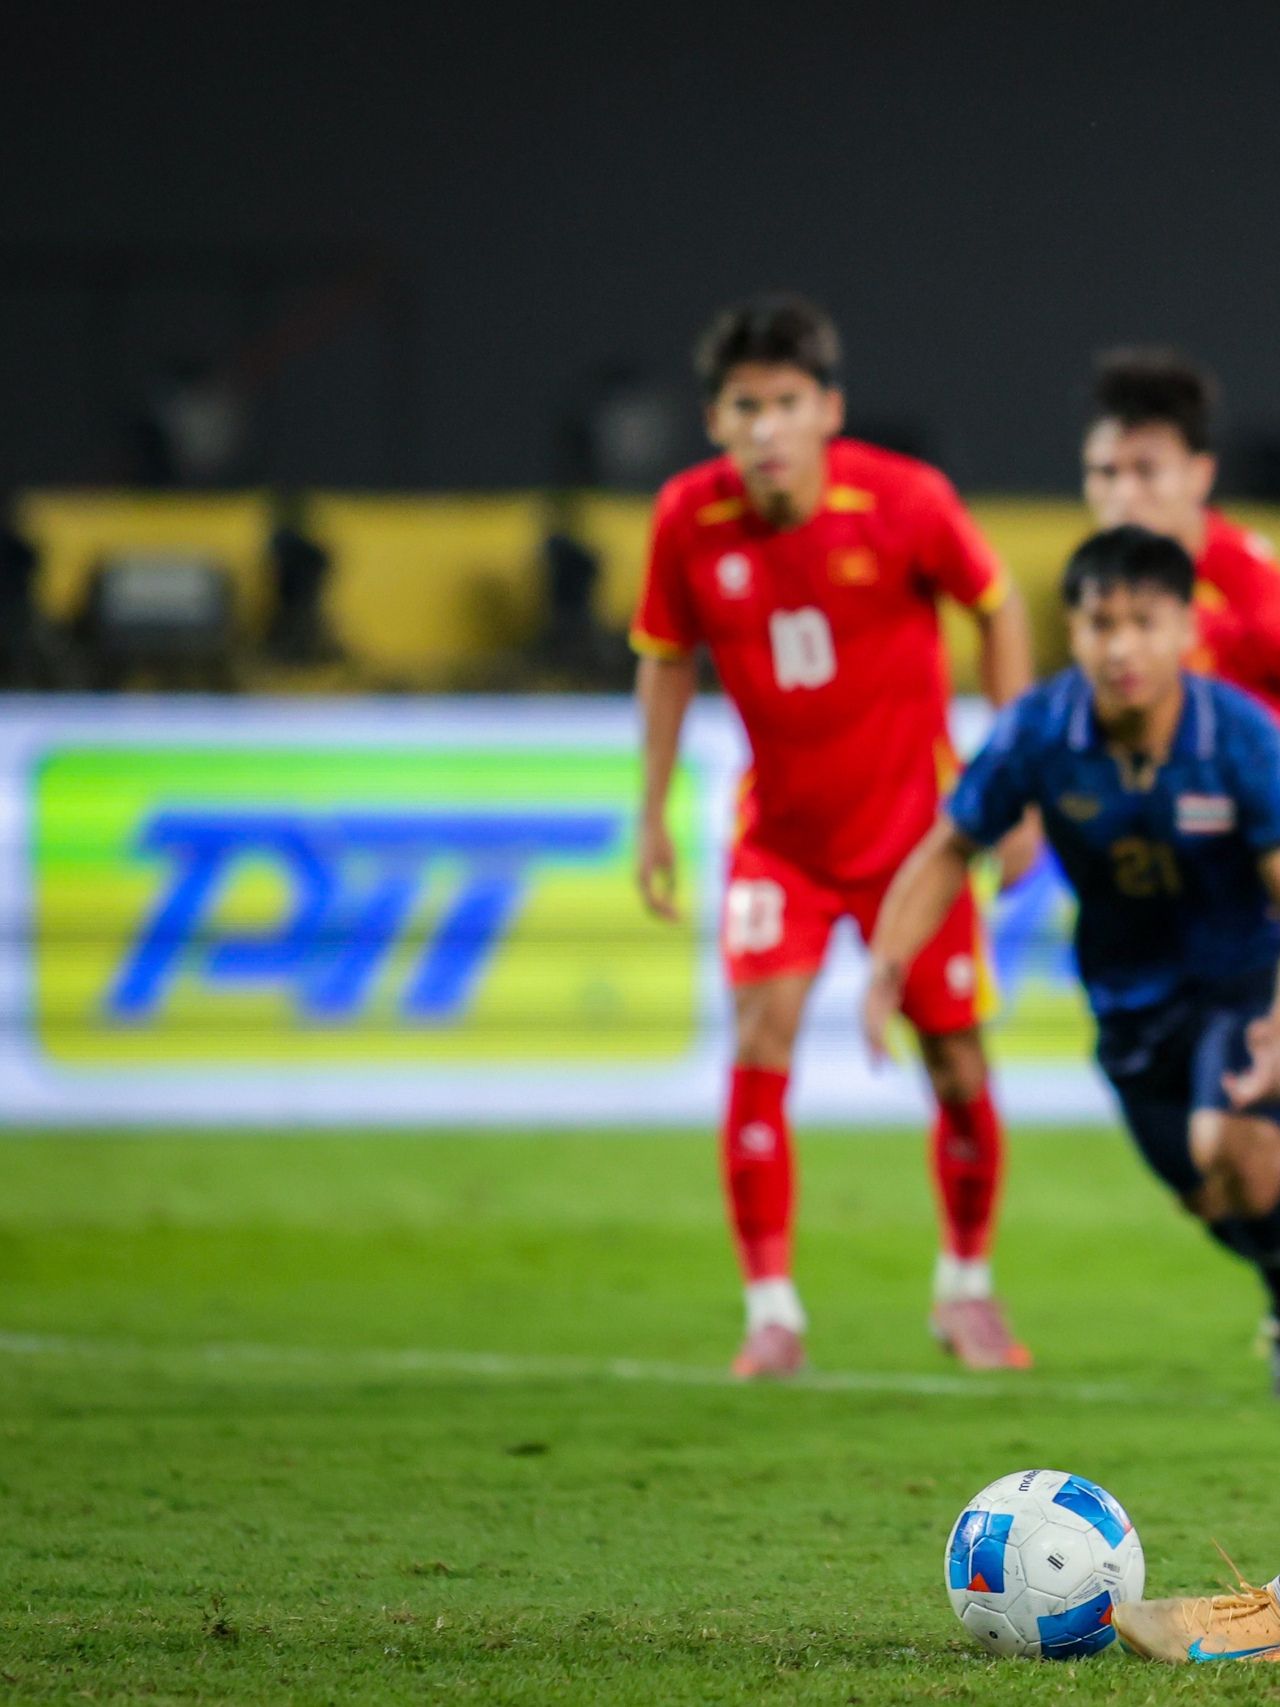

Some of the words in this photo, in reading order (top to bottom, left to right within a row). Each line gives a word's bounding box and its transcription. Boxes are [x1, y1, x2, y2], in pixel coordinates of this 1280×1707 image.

[769, 605, 838, 692] 10
[1110, 837, 1182, 896] 21
[108, 812, 618, 1016] PTT
